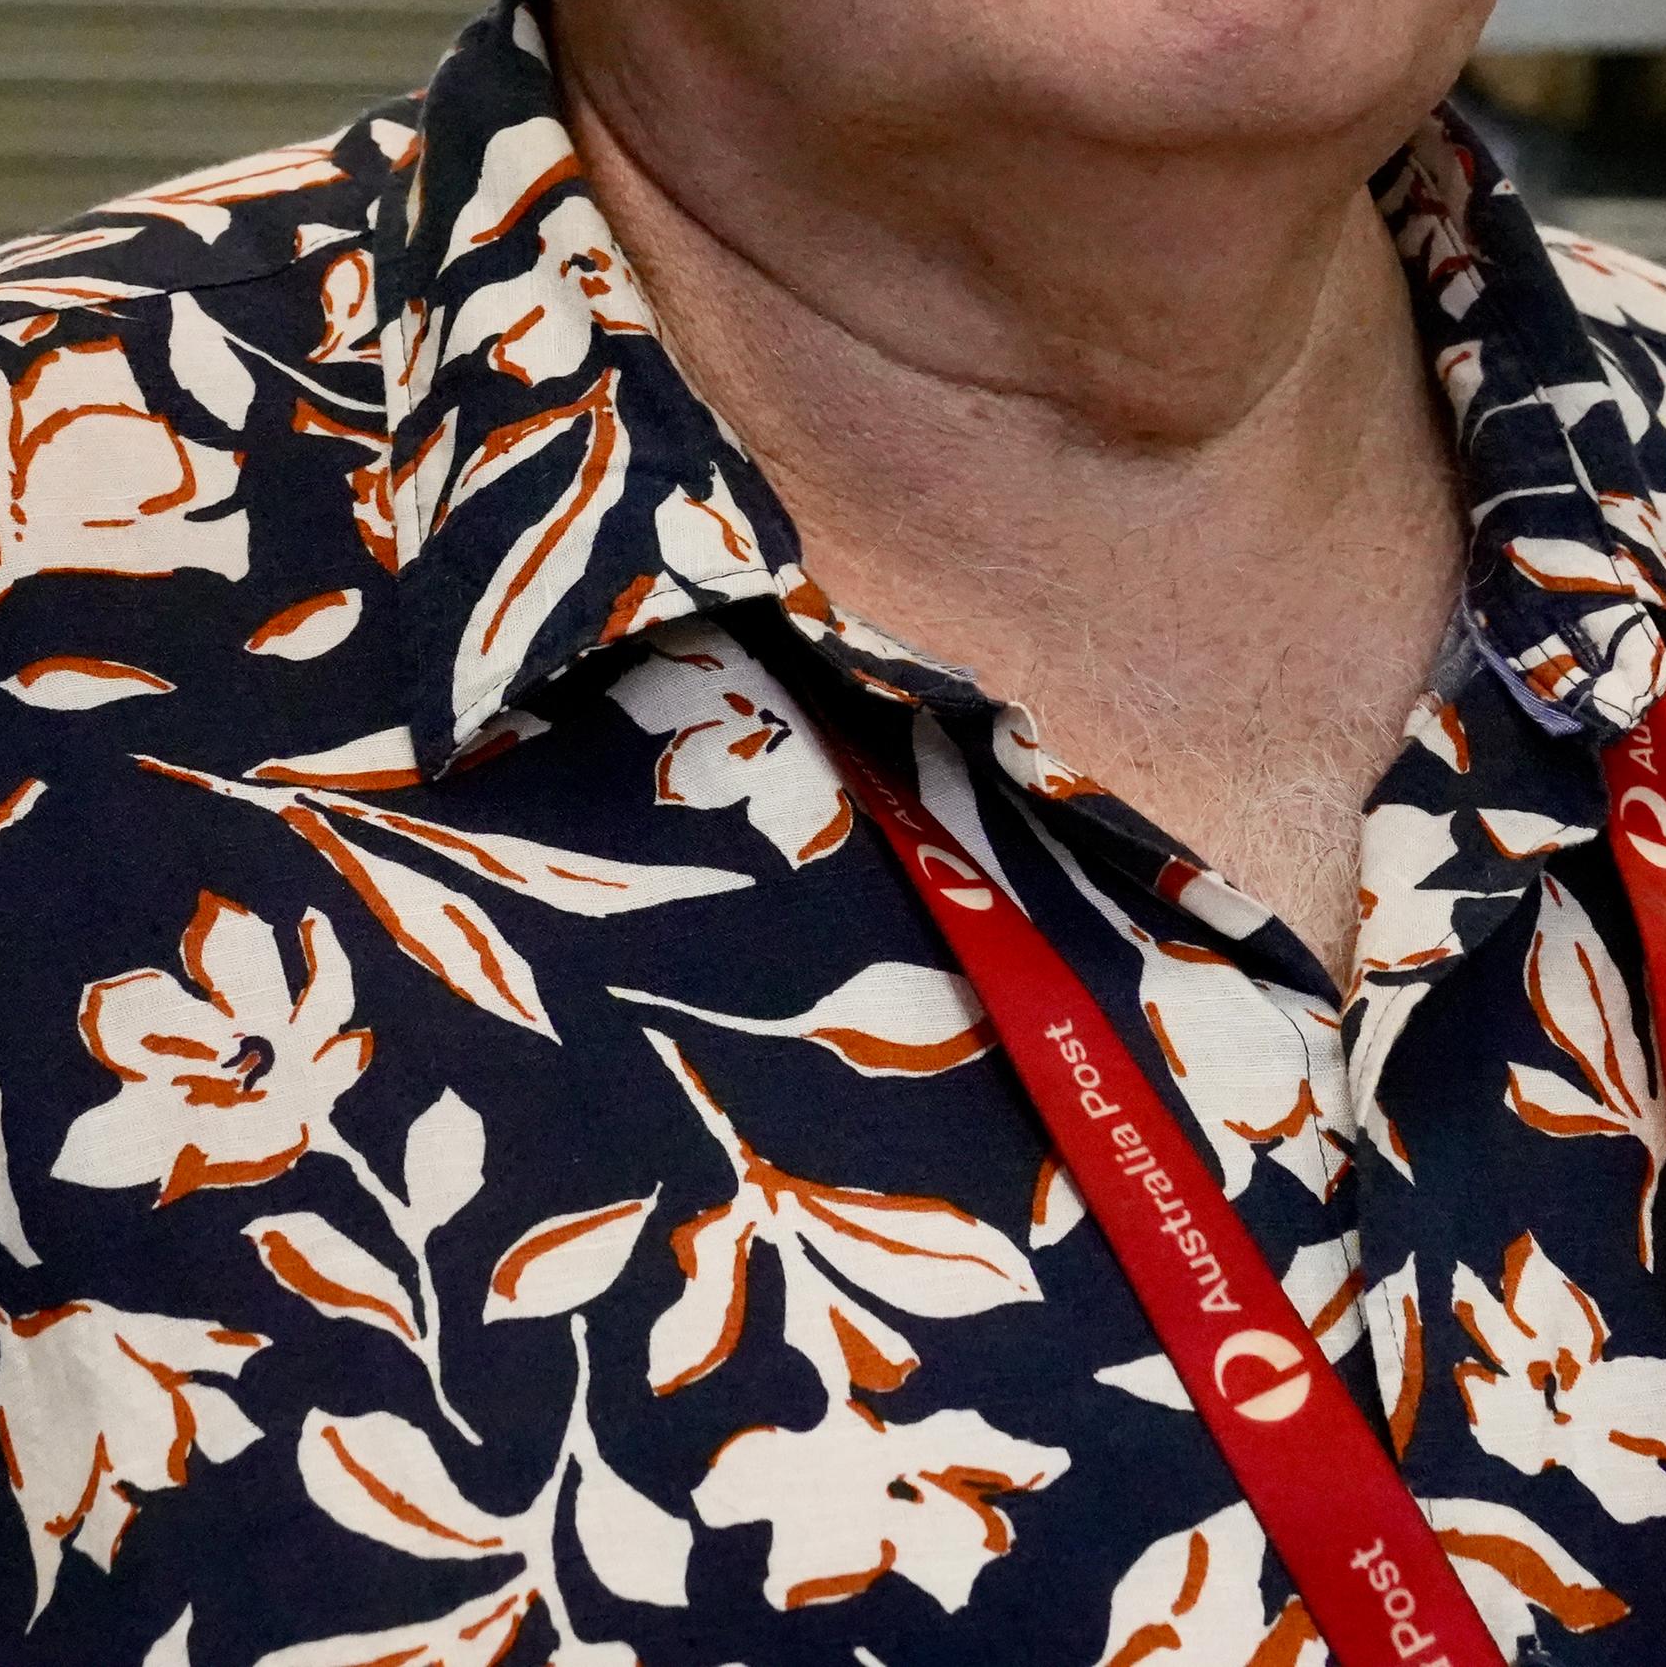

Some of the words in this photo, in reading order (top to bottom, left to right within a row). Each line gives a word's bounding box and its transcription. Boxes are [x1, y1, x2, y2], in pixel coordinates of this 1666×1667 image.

[1044, 1018, 1121, 1120] Post
[1110, 1122, 1243, 1313] Australia
[1349, 1537, 1437, 1659] Post
